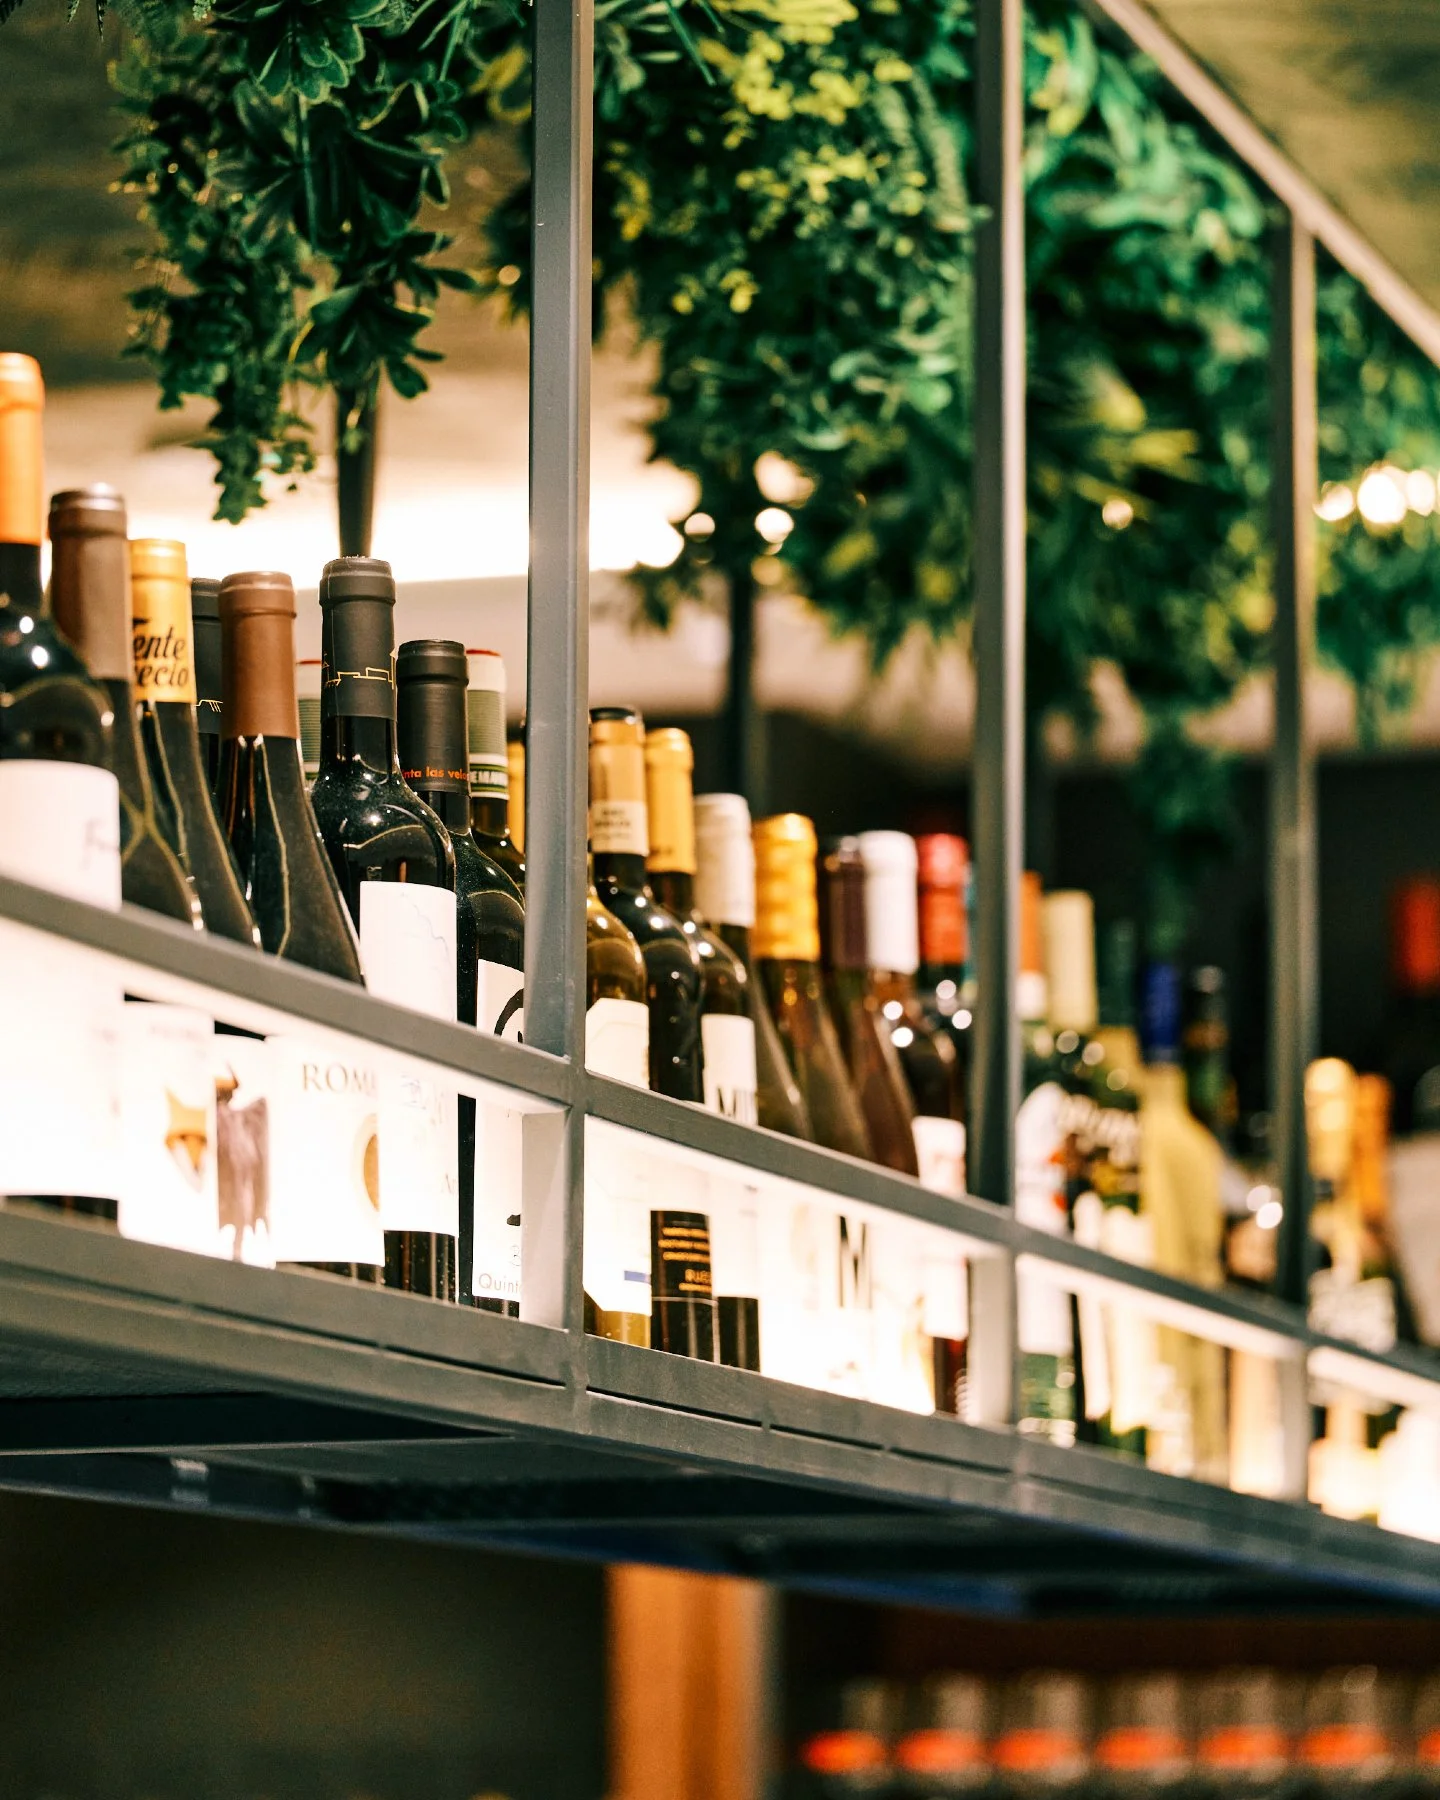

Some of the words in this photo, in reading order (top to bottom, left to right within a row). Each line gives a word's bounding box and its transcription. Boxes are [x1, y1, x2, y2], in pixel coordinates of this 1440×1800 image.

[134, 663, 189, 688] ecio
[426, 765, 444, 778] las
[478, 1272, 521, 1295] Quint
